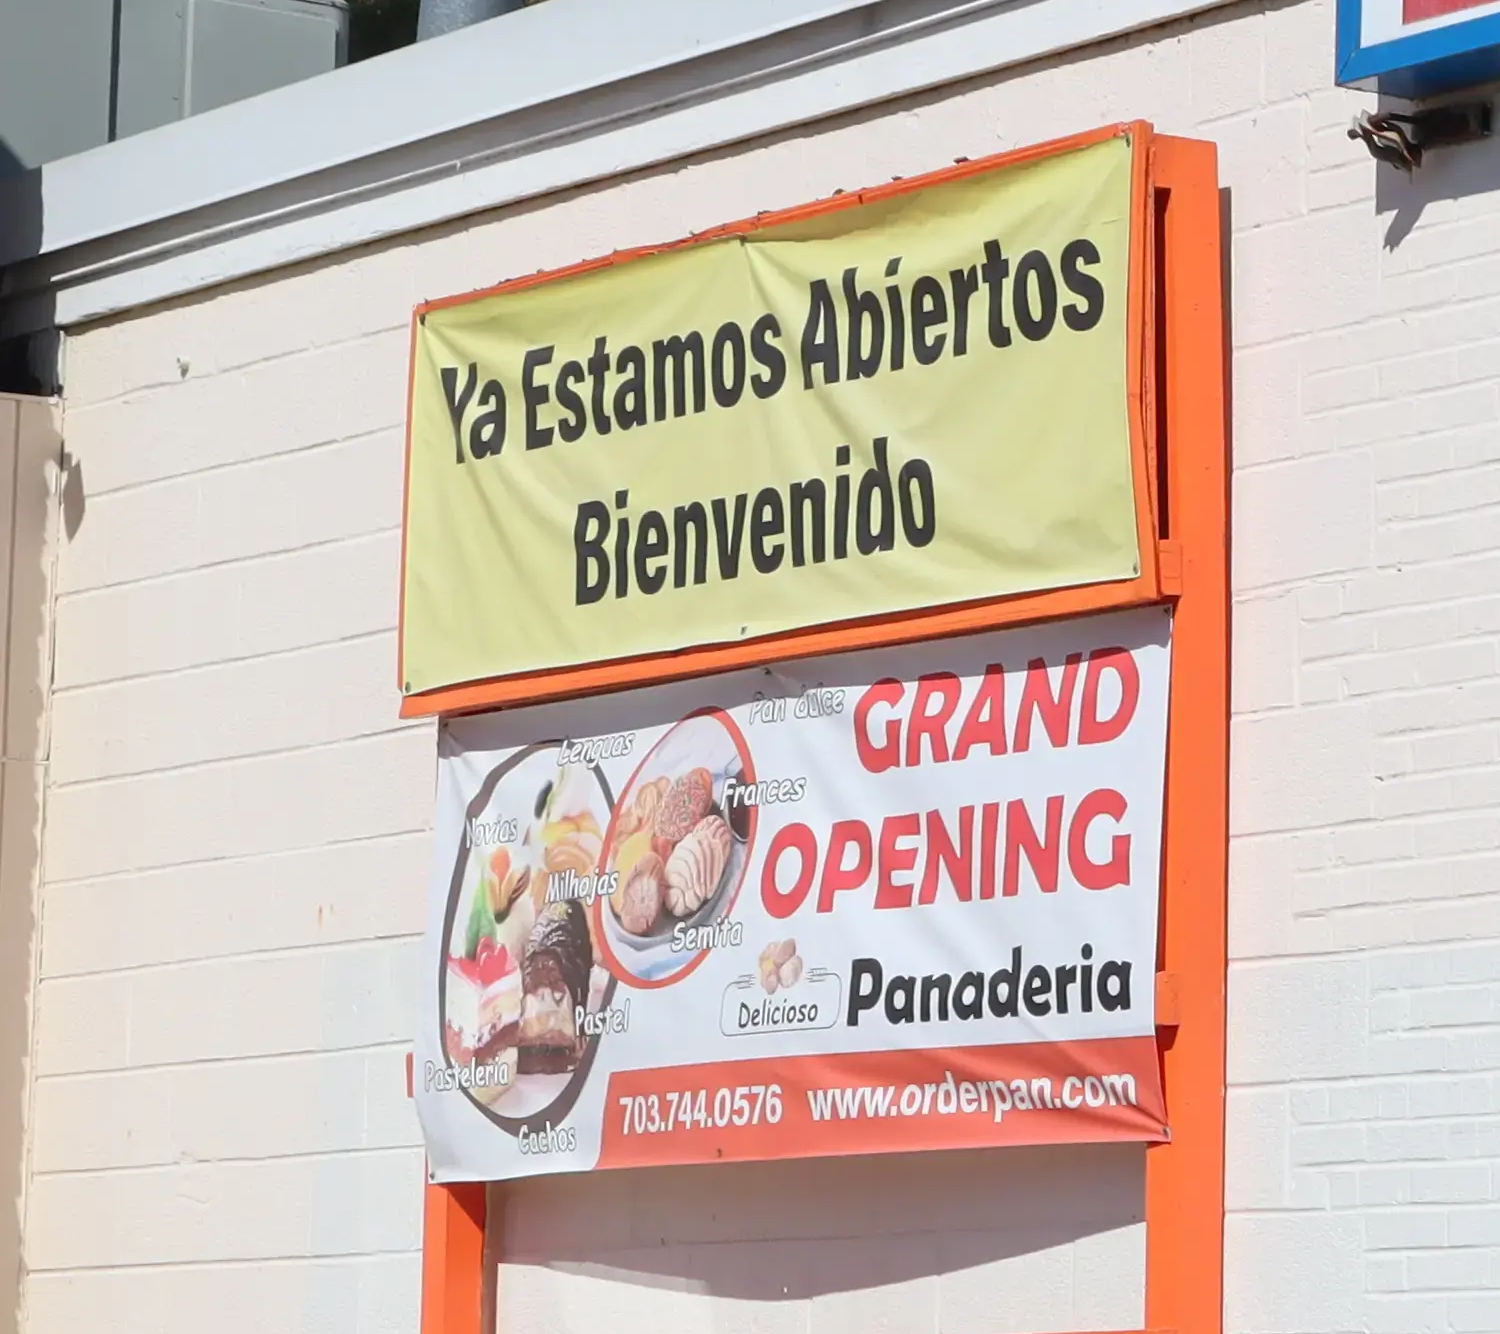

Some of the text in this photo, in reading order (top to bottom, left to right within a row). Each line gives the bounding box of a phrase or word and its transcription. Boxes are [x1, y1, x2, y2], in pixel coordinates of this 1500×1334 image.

[441, 238, 1106, 464] Ya Estamos Abiertos
[574, 437, 936, 607] Bienvenido
[750, 681, 846, 725] Pan dulce
[853, 645, 1140, 774] GRAND
[557, 733, 635, 768] Lenguas
[720, 777, 806, 810] Frances
[466, 815, 518, 848] Novias
[759, 788, 1132, 920] OPENING
[545, 867, 620, 906] Milhojas
[670, 916, 743, 952] Semita
[846, 942, 1132, 1026] Panaderia
[574, 998, 630, 1036] Pastel
[738, 999, 818, 1028] Delicioso
[424, 1056, 509, 1092] Pasteleria
[619, 1070, 1138, 1135] 703.744.0576 www.orderpan.com
[517, 1122, 577, 1154] Cachos
